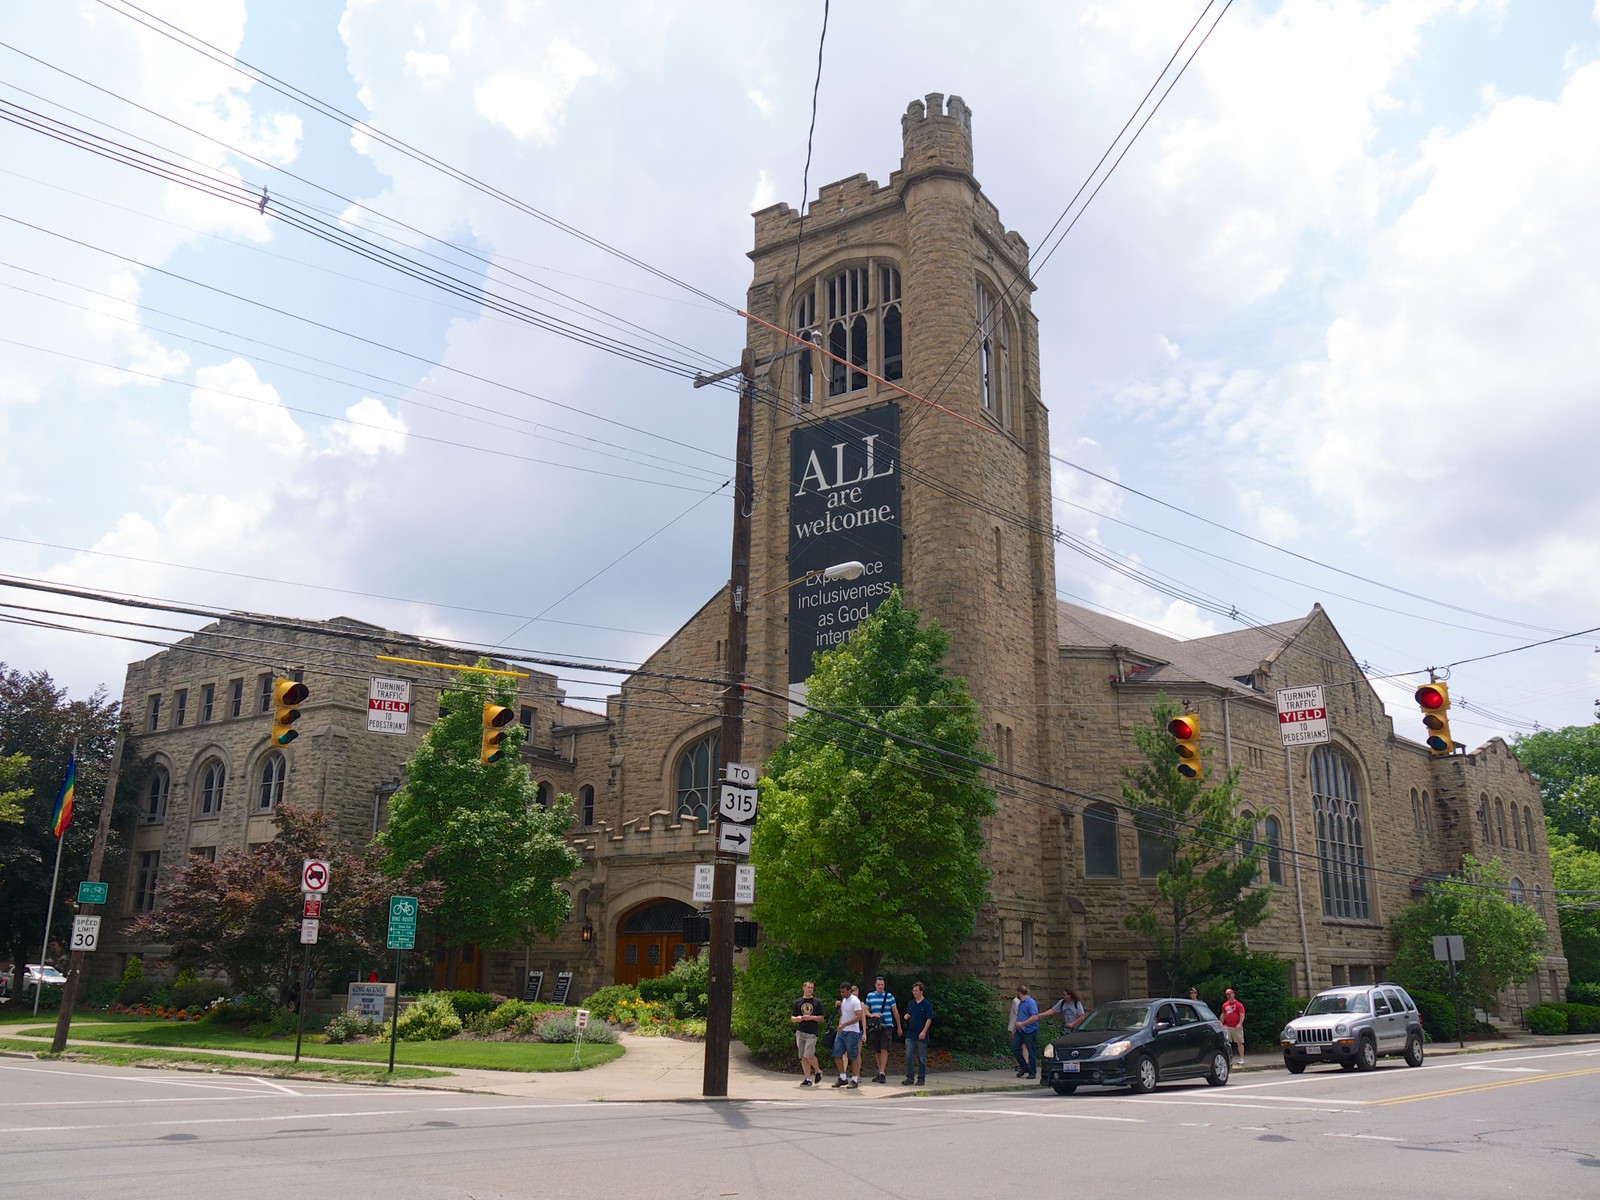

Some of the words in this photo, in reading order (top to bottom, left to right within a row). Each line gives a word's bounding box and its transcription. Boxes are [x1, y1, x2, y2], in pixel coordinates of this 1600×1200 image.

[794, 433, 894, 497] ALL
[827, 486, 863, 509] are
[795, 504, 896, 539] welcome.
[798, 581, 891, 609] inclusiveness
[818, 612, 834, 627] as
[838, 601, 869, 623] God
[376, 681, 405, 692] TURNING
[377, 690, 404, 700] TRAFFIC
[1283, 690, 1317, 701] TURNING
[373, 700, 406, 711] YIELD
[1286, 699, 1317, 710] TRAFFIC
[385, 712, 392, 721] TO
[1283, 709, 1322, 722] YIELD
[369, 720, 406, 731] PEDESTRIANS
[1300, 722, 1308, 731] TO
[1283, 729, 1327, 742] PEDESTRIANS
[733, 767, 750, 780] TO
[725, 793, 752, 812] 315
[74, 933, 95, 947] 30
